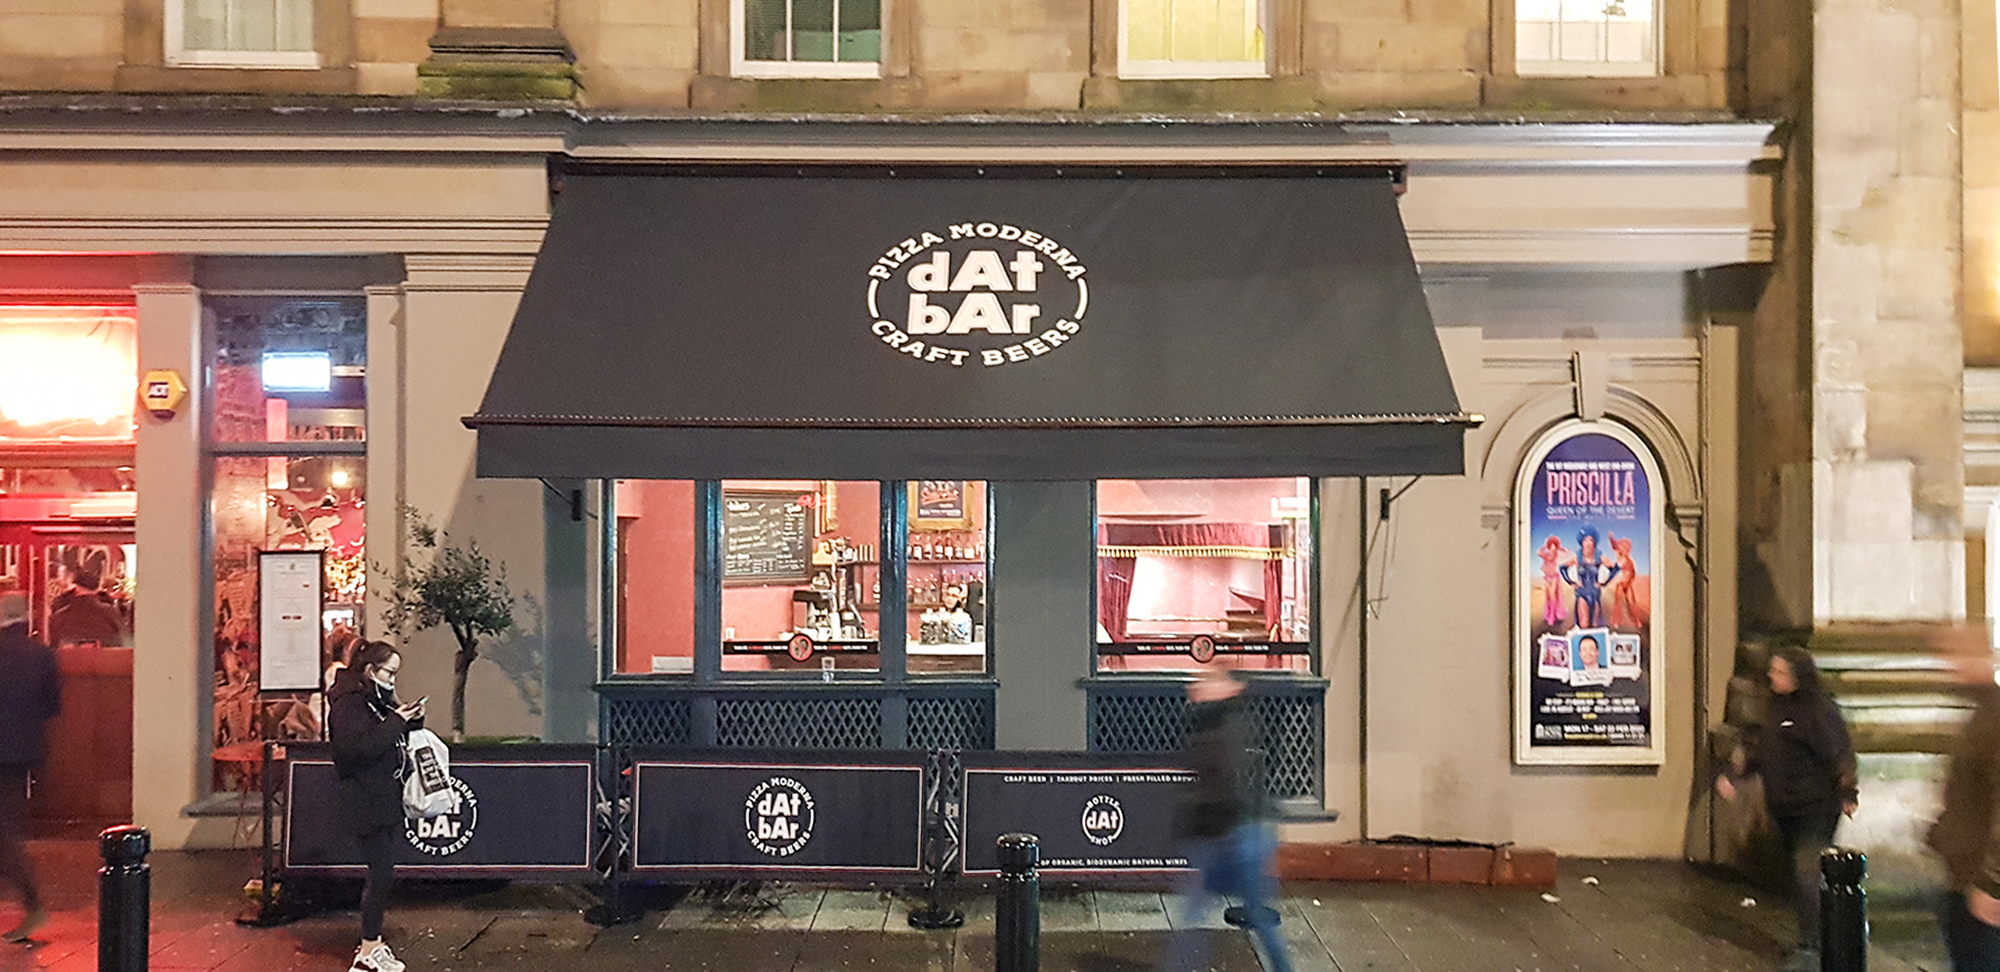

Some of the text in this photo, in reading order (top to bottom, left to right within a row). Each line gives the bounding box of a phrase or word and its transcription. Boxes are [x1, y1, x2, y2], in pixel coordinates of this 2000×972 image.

[868, 222, 1087, 280] PIZZA MODERNA
[907, 250, 1044, 292] dAt
[907, 292, 1041, 335] bAr
[871, 319, 1080, 366] CRAFT BEERS
[1547, 471, 1635, 506] PRISCILLA
[1003, 775, 1027, 783] CRAFT
[1028, 775, 1047, 783] BEER
[1056, 775, 1087, 783] TAKEOUT
[1089, 775, 1113, 783] PRICES
[1123, 775, 1145, 783] FRESH
[1146, 775, 1171, 783] FILLED
[745, 777, 815, 810] PIZZA MODERNA
[757, 793, 802, 816] dAt
[1086, 795, 1120, 808] BOTTLE
[417, 815, 461, 838] bAr
[758, 816, 800, 839] bAr
[1086, 811, 1119, 829] dAt
[405, 829, 474, 856] CRAFT BEERS
[747, 830, 811, 856] CRAFT BEERS
[1091, 835, 1114, 846] SHOP
[1086, 858, 1130, 866] BIODYNAMIC
[1131, 858, 1164, 866] NATURAL
[1165, 858, 1188, 866] WINES
